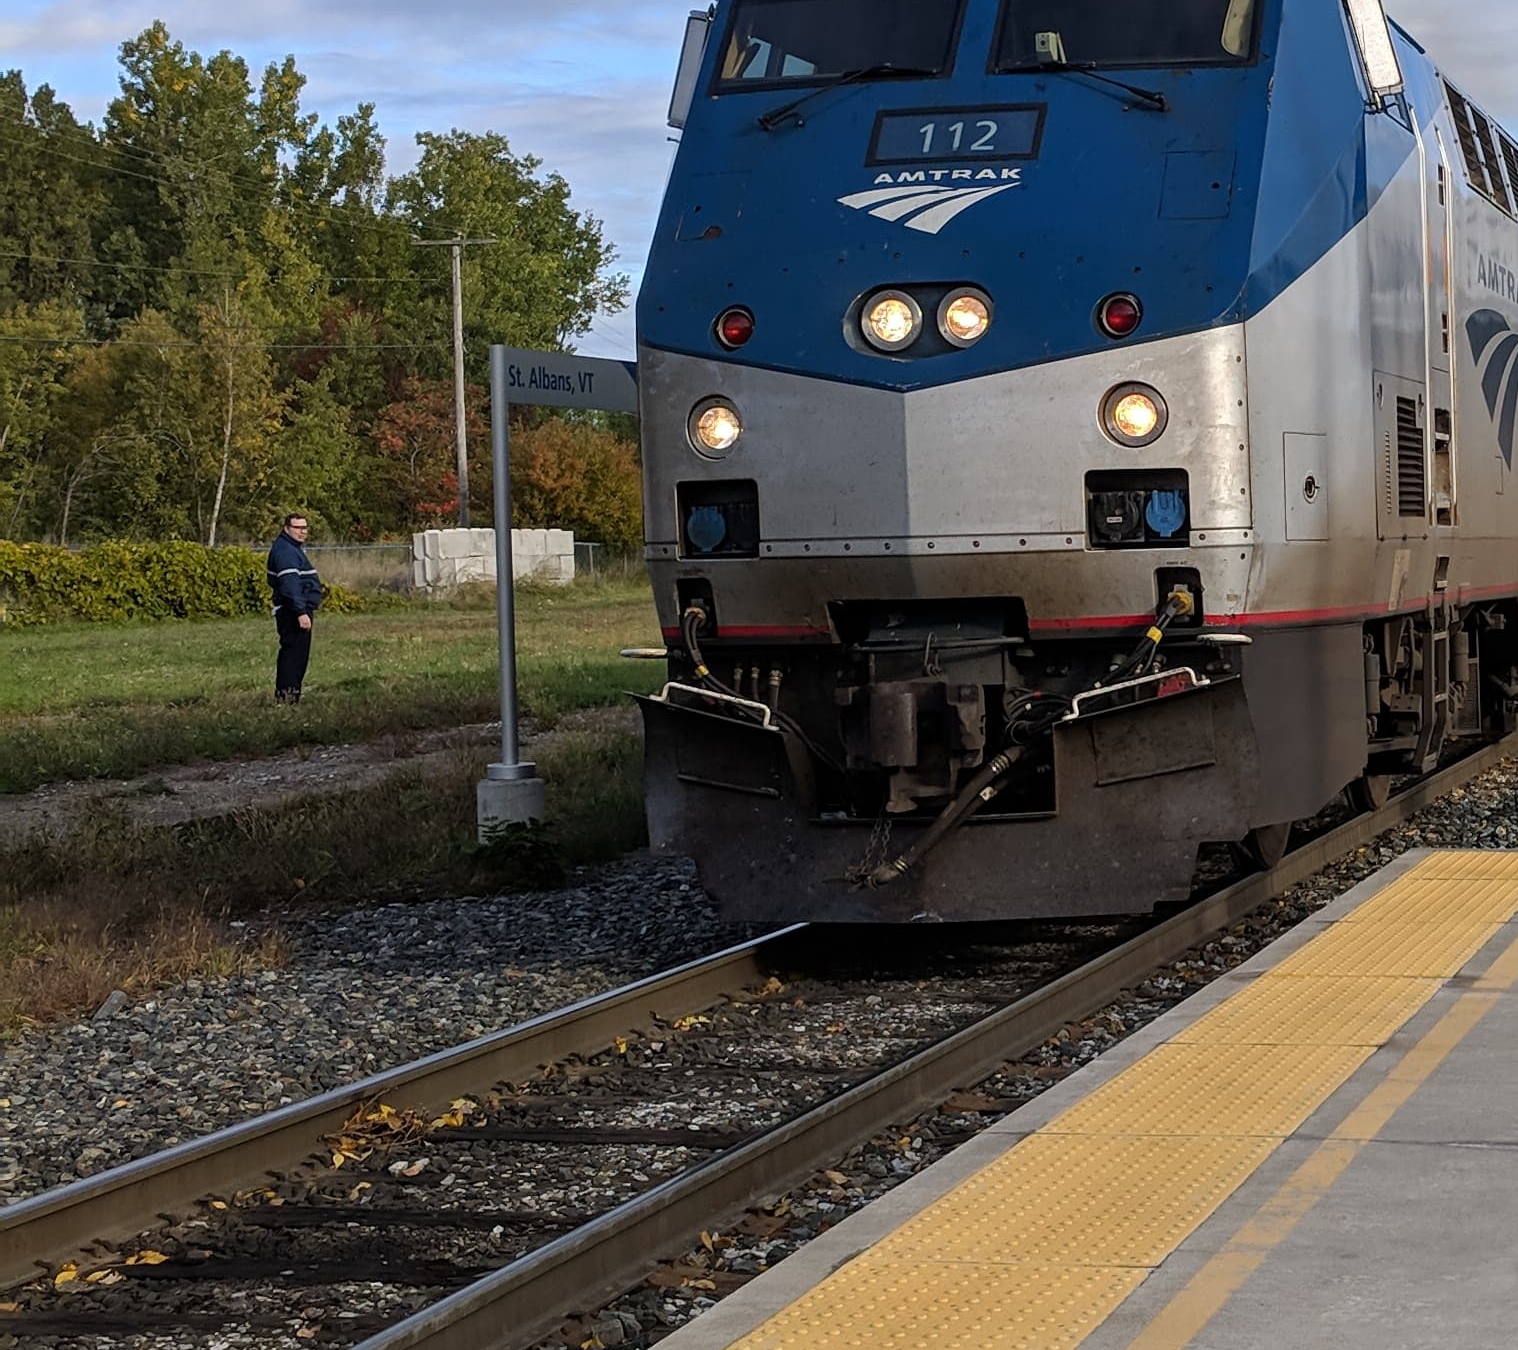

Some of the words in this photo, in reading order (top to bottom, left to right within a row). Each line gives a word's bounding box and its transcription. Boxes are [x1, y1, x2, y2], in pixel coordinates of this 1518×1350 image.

[919, 120, 998, 153] 112
[873, 168, 1022, 184] AMTRAK
[508, 364, 525, 388] St.
[528, 365, 575, 395] Albans,
[578, 370, 595, 394] VT
